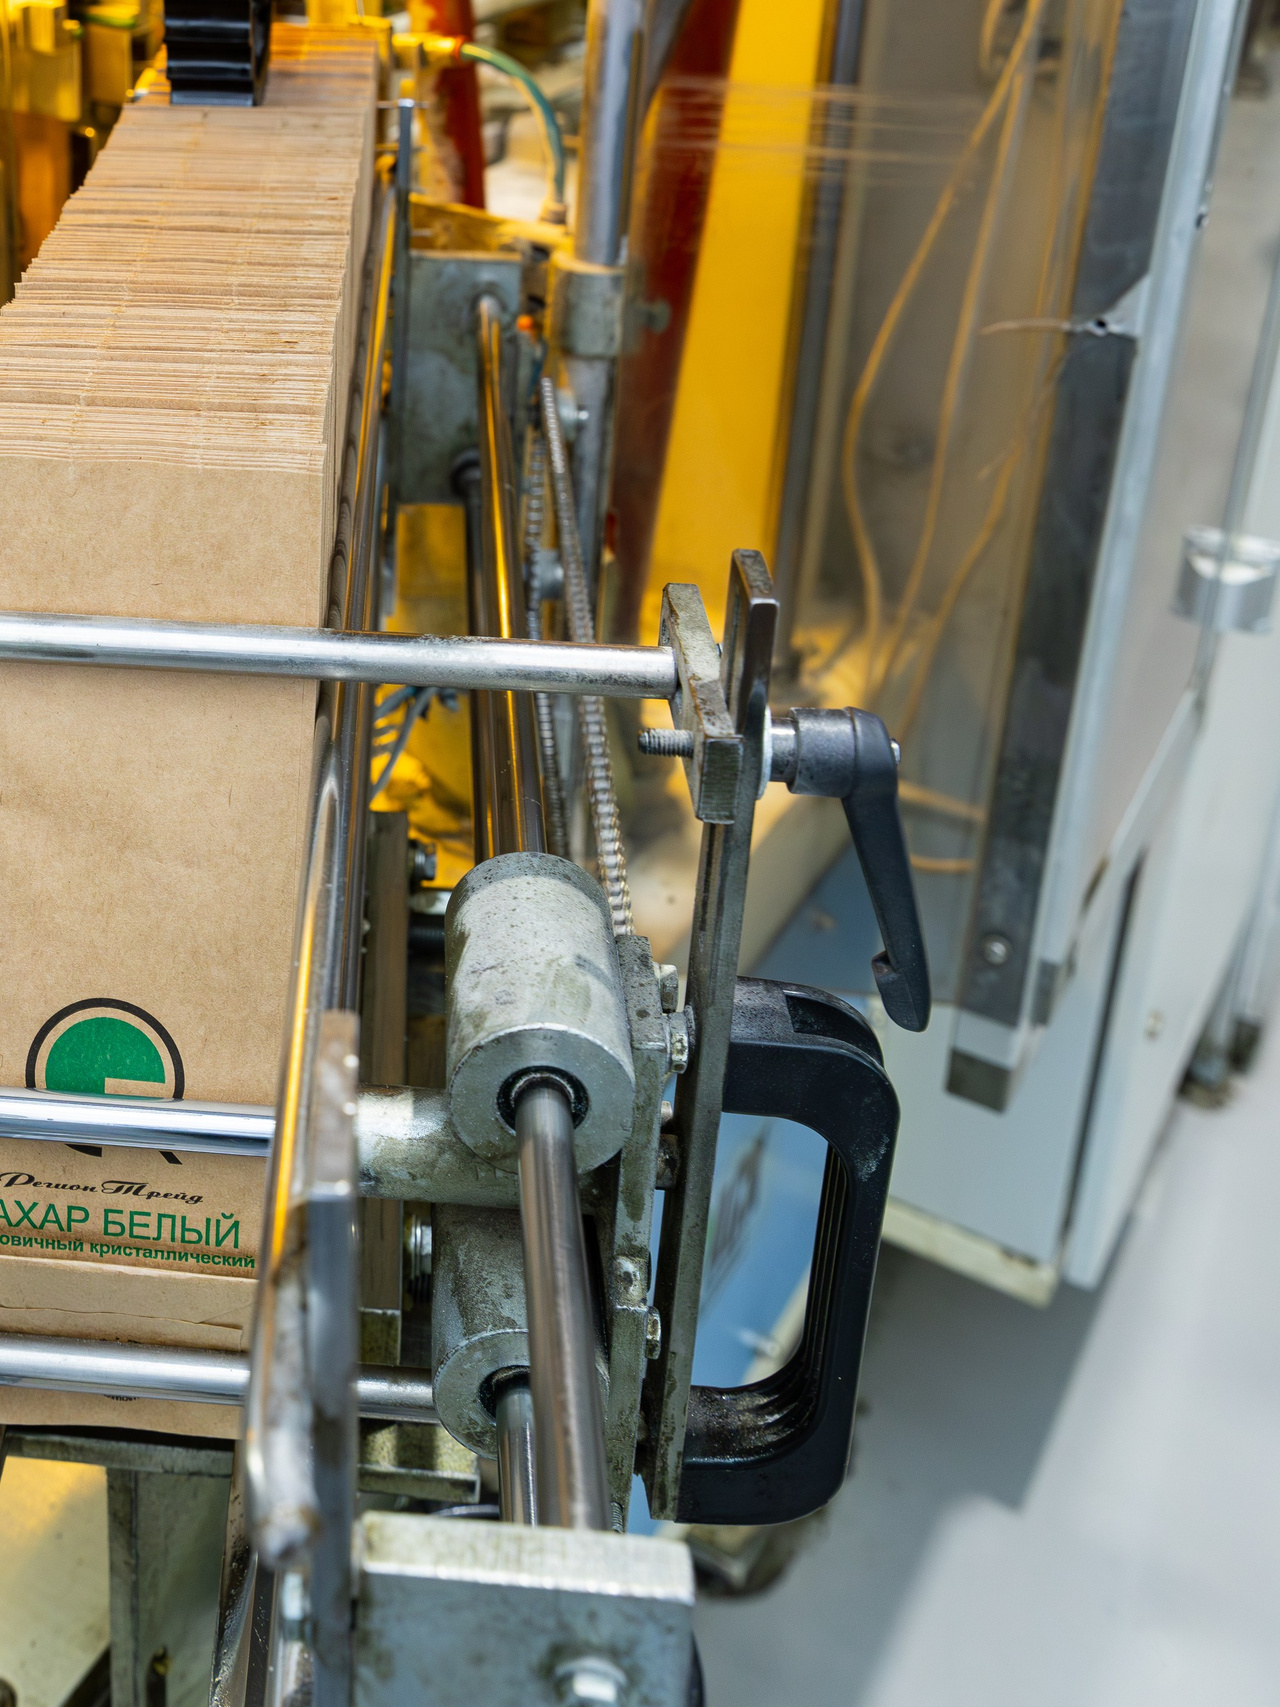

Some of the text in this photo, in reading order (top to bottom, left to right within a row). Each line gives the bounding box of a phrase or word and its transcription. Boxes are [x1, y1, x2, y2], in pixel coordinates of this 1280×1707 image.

[101, 1180, 204, 1205] Трейд
[104, 1208, 241, 1249] БЕЛЫЙ
[90, 1242, 256, 1269] кристаллический
